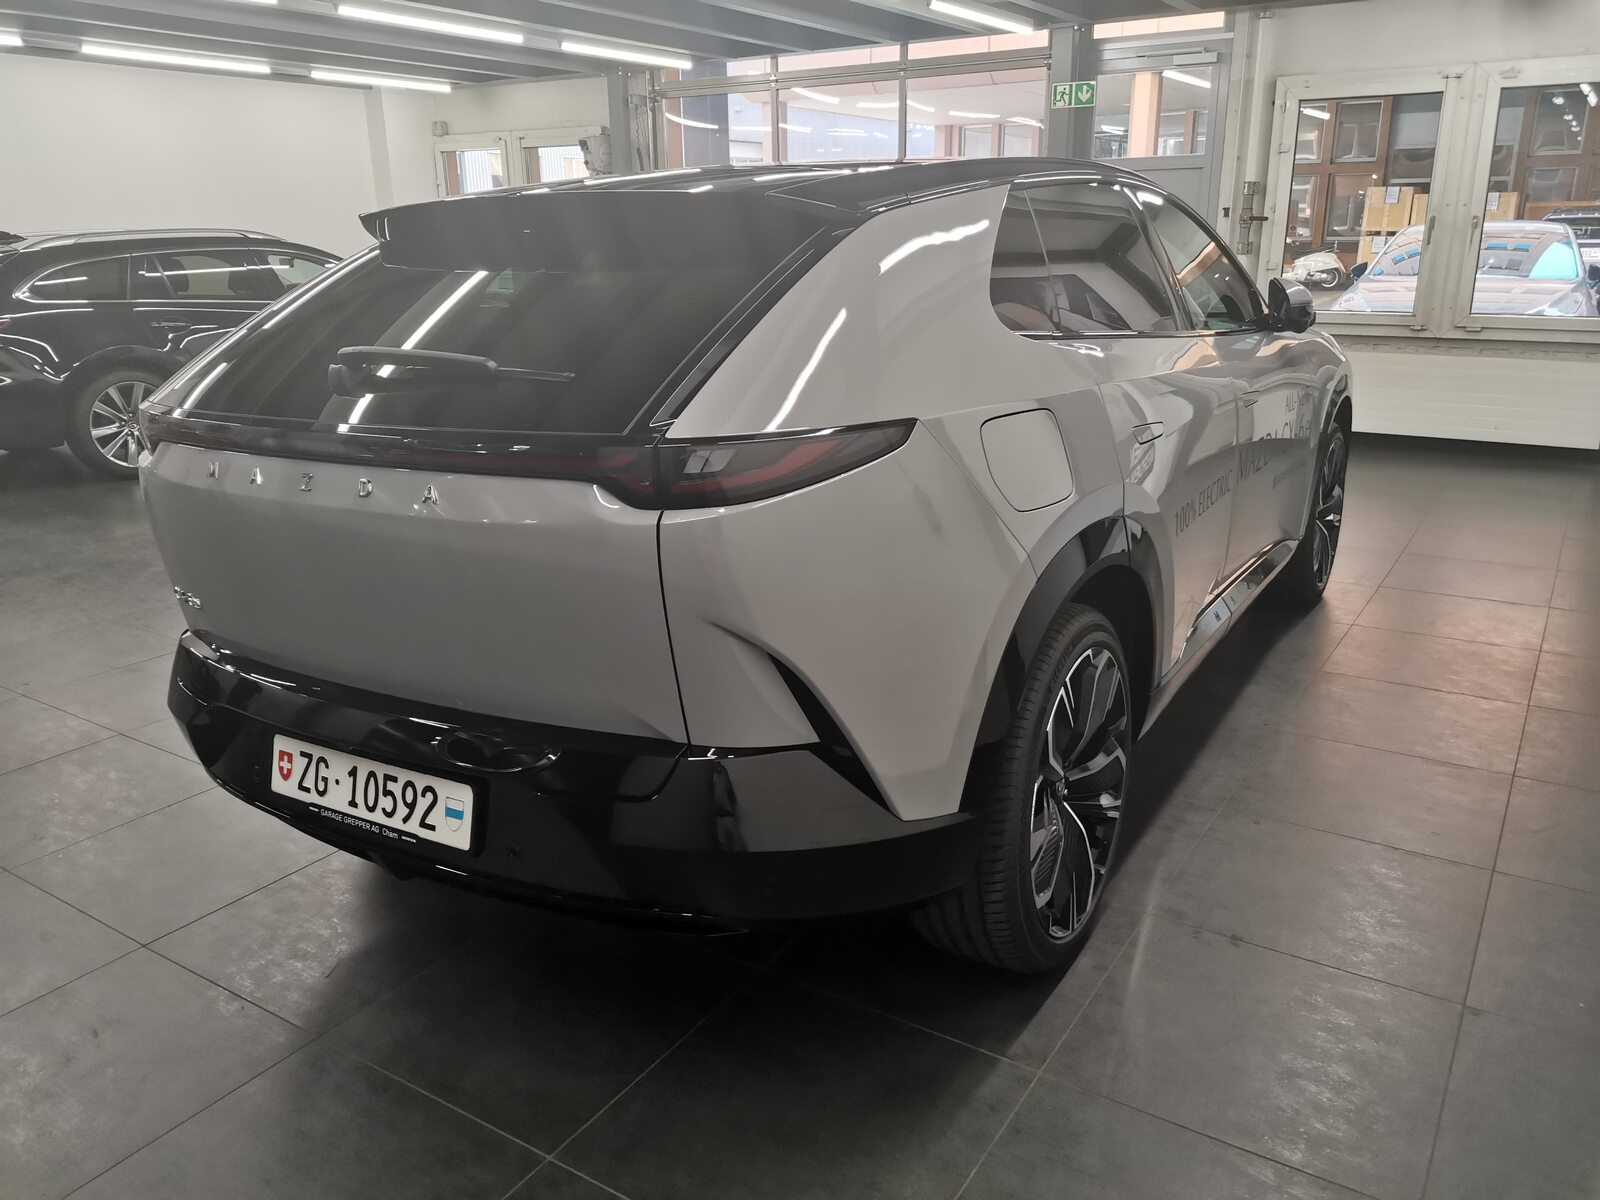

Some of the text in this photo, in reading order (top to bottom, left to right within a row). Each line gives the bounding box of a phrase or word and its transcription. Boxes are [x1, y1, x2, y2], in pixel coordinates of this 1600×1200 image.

[208, 460, 440, 504] MAZDA
[1174, 498, 1196, 537] 100%
[1198, 469, 1233, 516] ELECTRIC
[320, 808, 343, 822] GARAGE
[343, 815, 371, 831] GREPPER
[370, 824, 380, 834] AG
[382, 828, 399, 840] Cham
